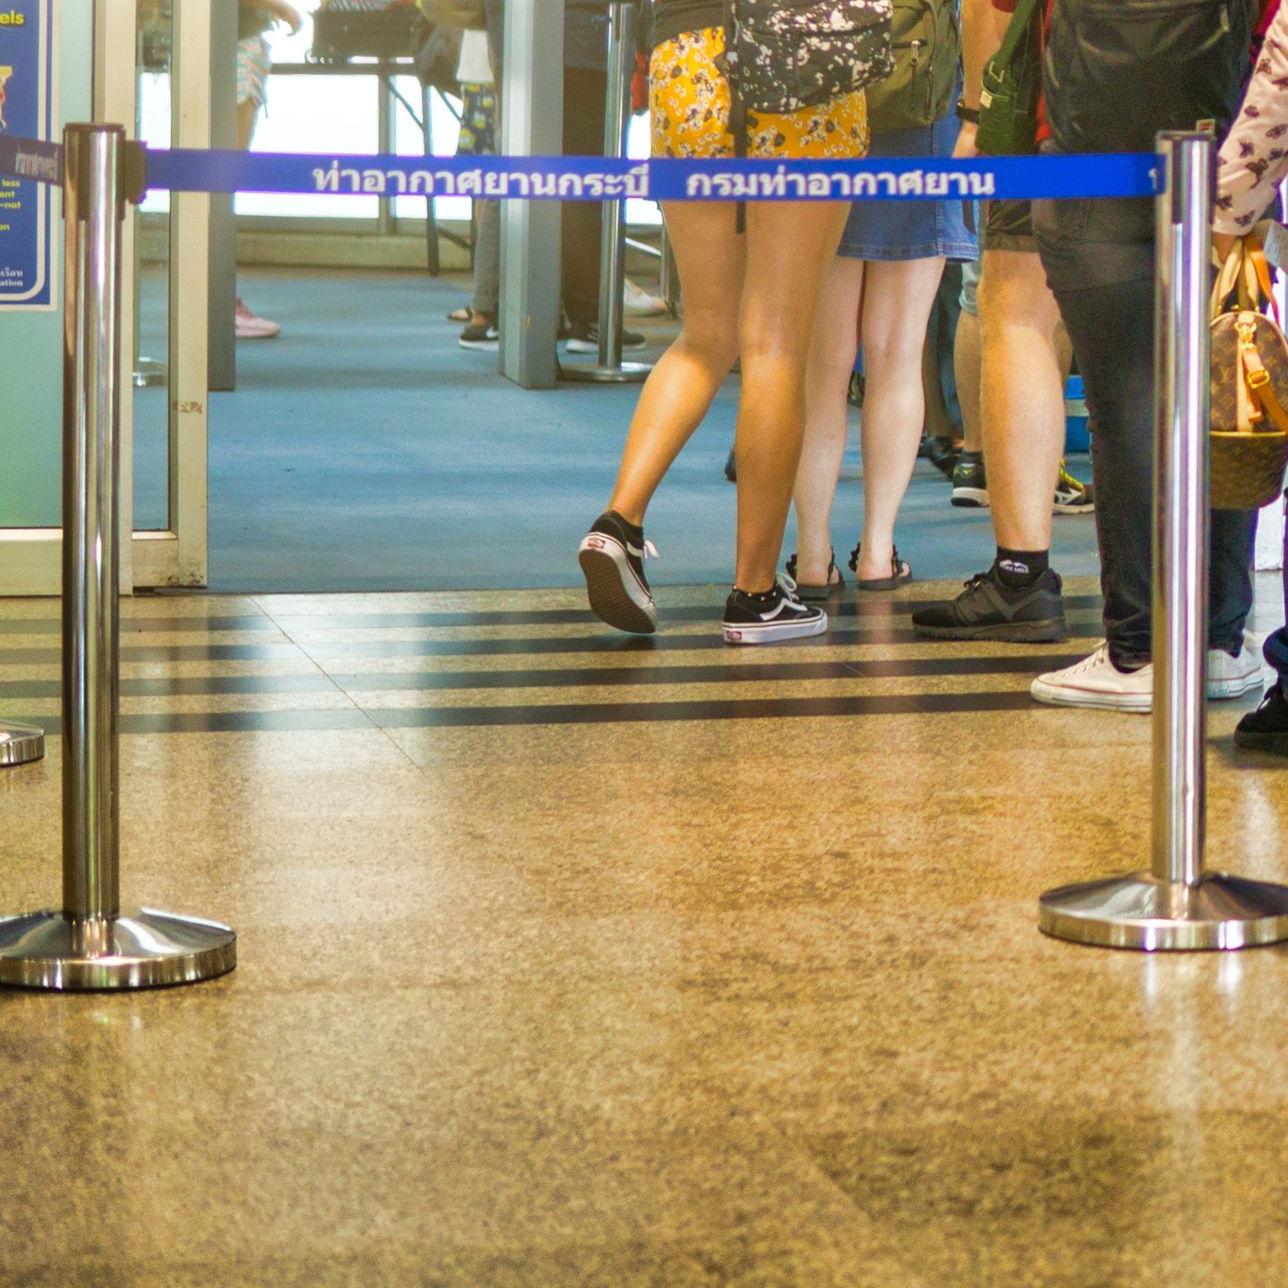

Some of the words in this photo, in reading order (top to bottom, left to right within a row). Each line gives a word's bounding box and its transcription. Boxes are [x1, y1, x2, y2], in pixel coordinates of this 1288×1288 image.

[686, 165, 996, 197] กรมท่าอากาศยาน
